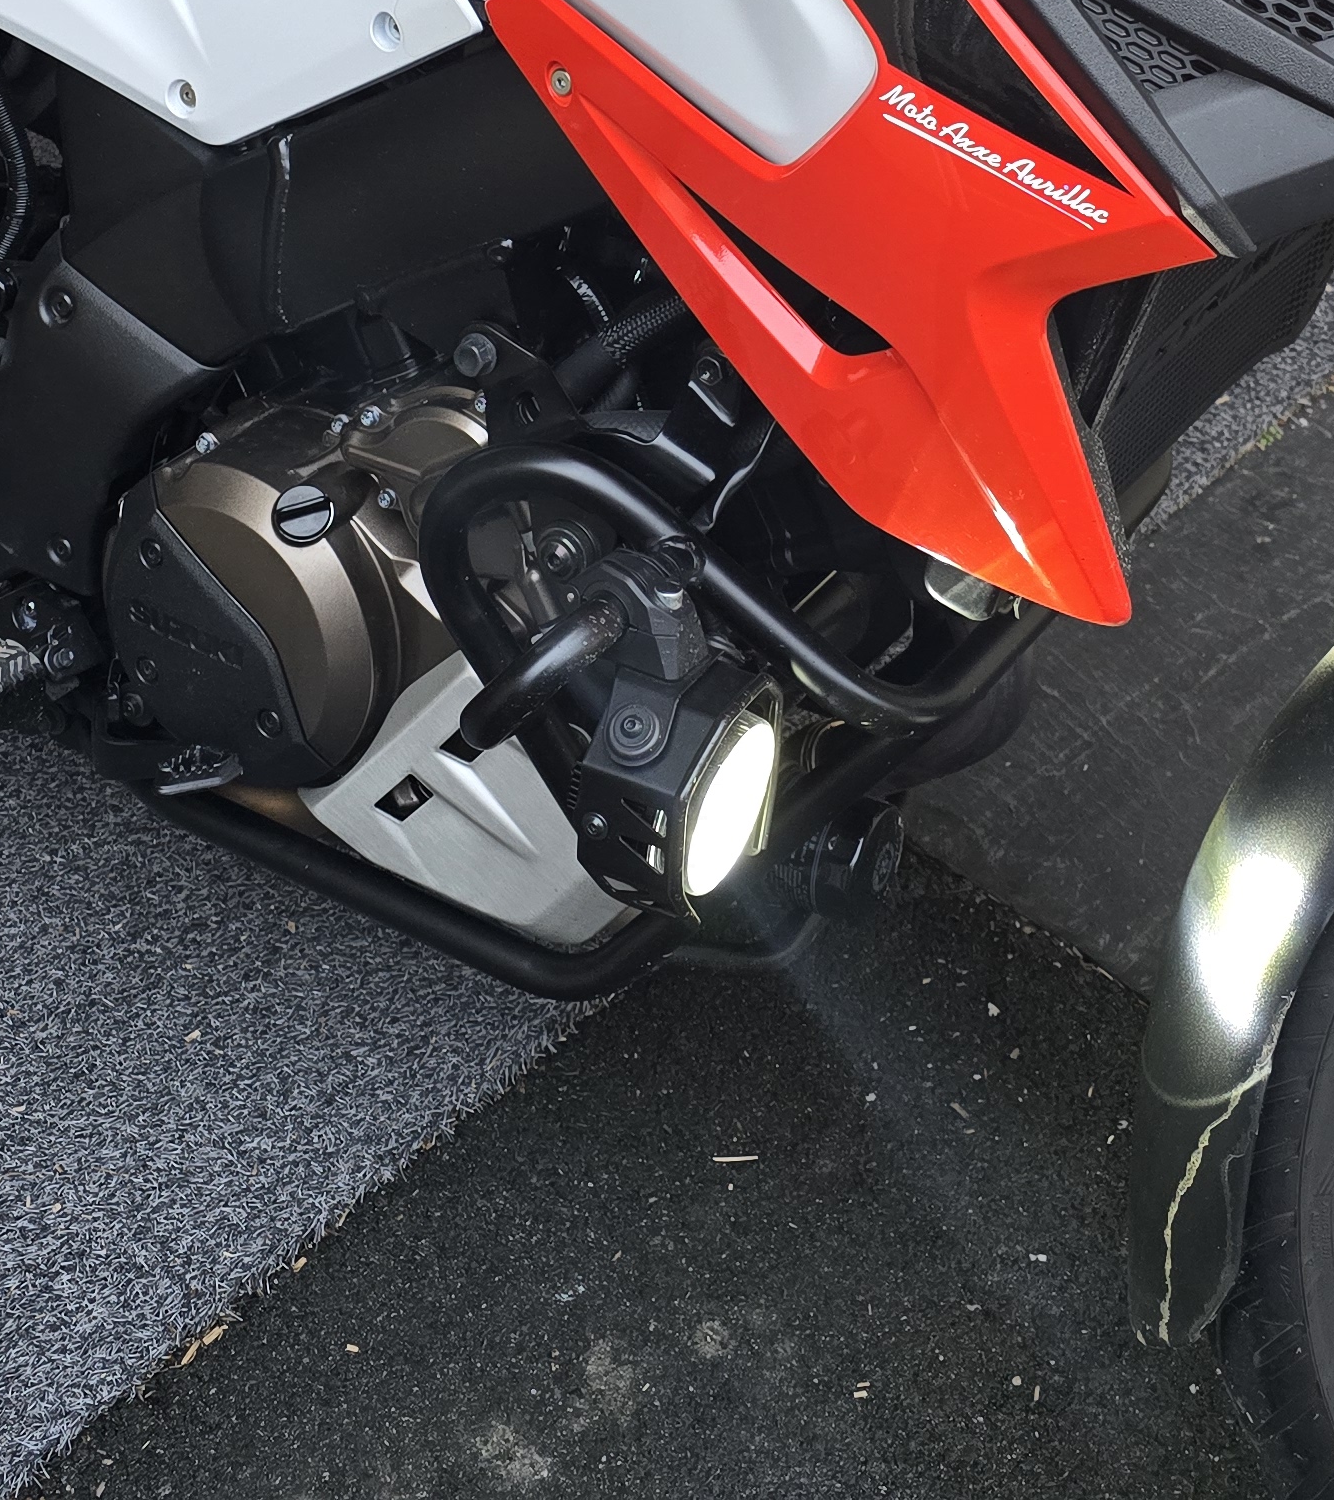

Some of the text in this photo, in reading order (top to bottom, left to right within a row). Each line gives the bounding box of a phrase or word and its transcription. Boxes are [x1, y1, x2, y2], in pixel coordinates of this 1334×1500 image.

[879, 84, 1111, 225] Moto Axxe Aurillac
